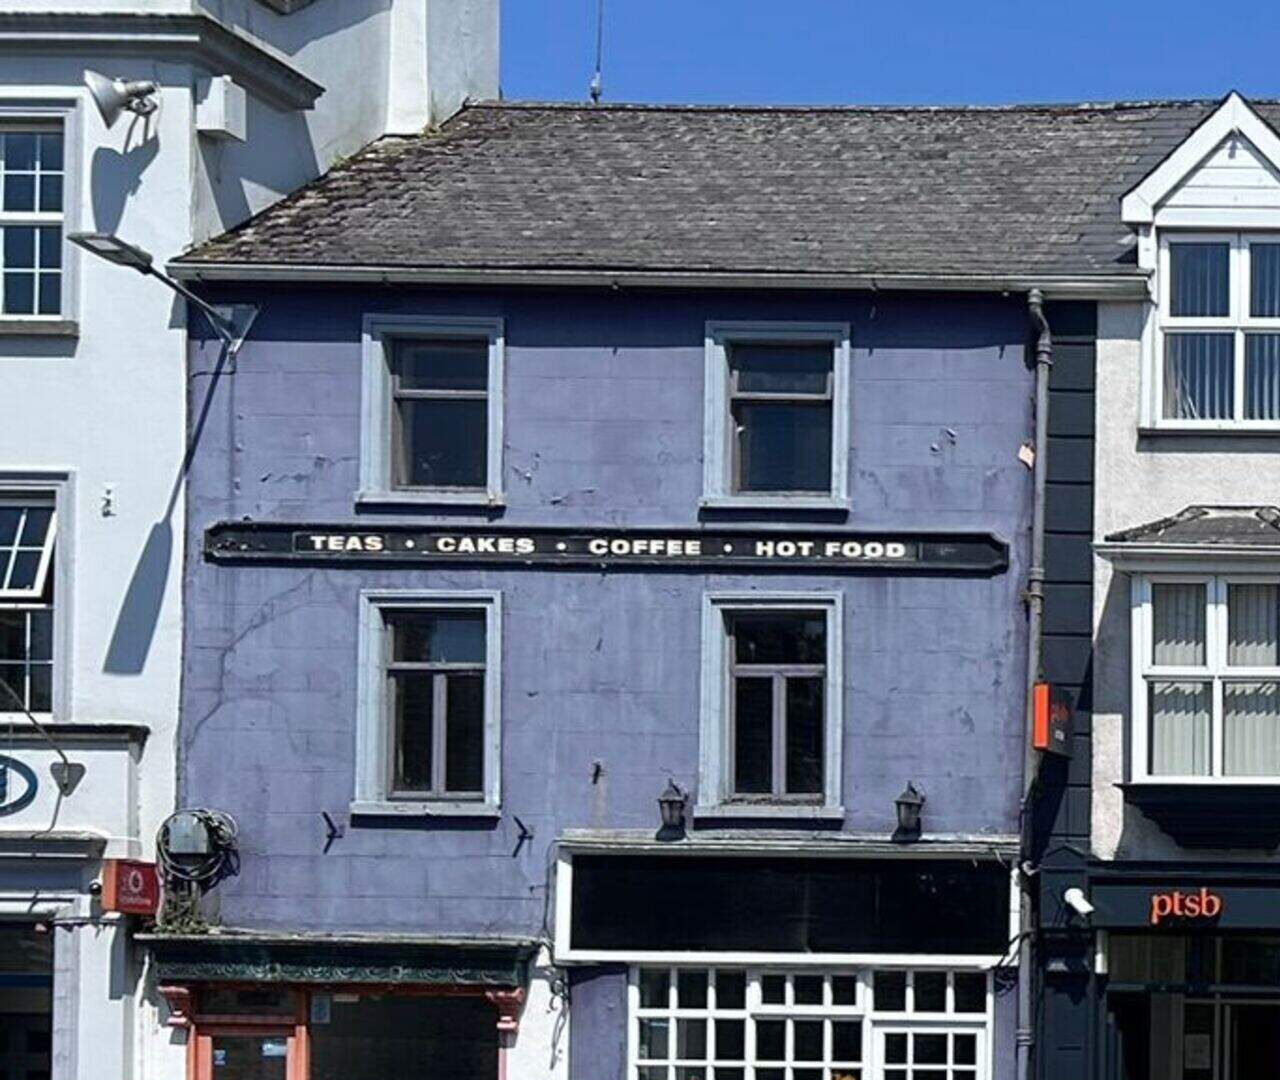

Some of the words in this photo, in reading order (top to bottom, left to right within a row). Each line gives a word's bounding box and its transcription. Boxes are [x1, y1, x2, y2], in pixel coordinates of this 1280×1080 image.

[310, 535, 384, 551] TEAS
[437, 537, 536, 553] CAKES
[588, 539, 701, 556] COFFEE
[755, 541, 811, 557] HOT
[825, 542, 907, 558] FOOD
[1151, 886, 1221, 925] ptsb
